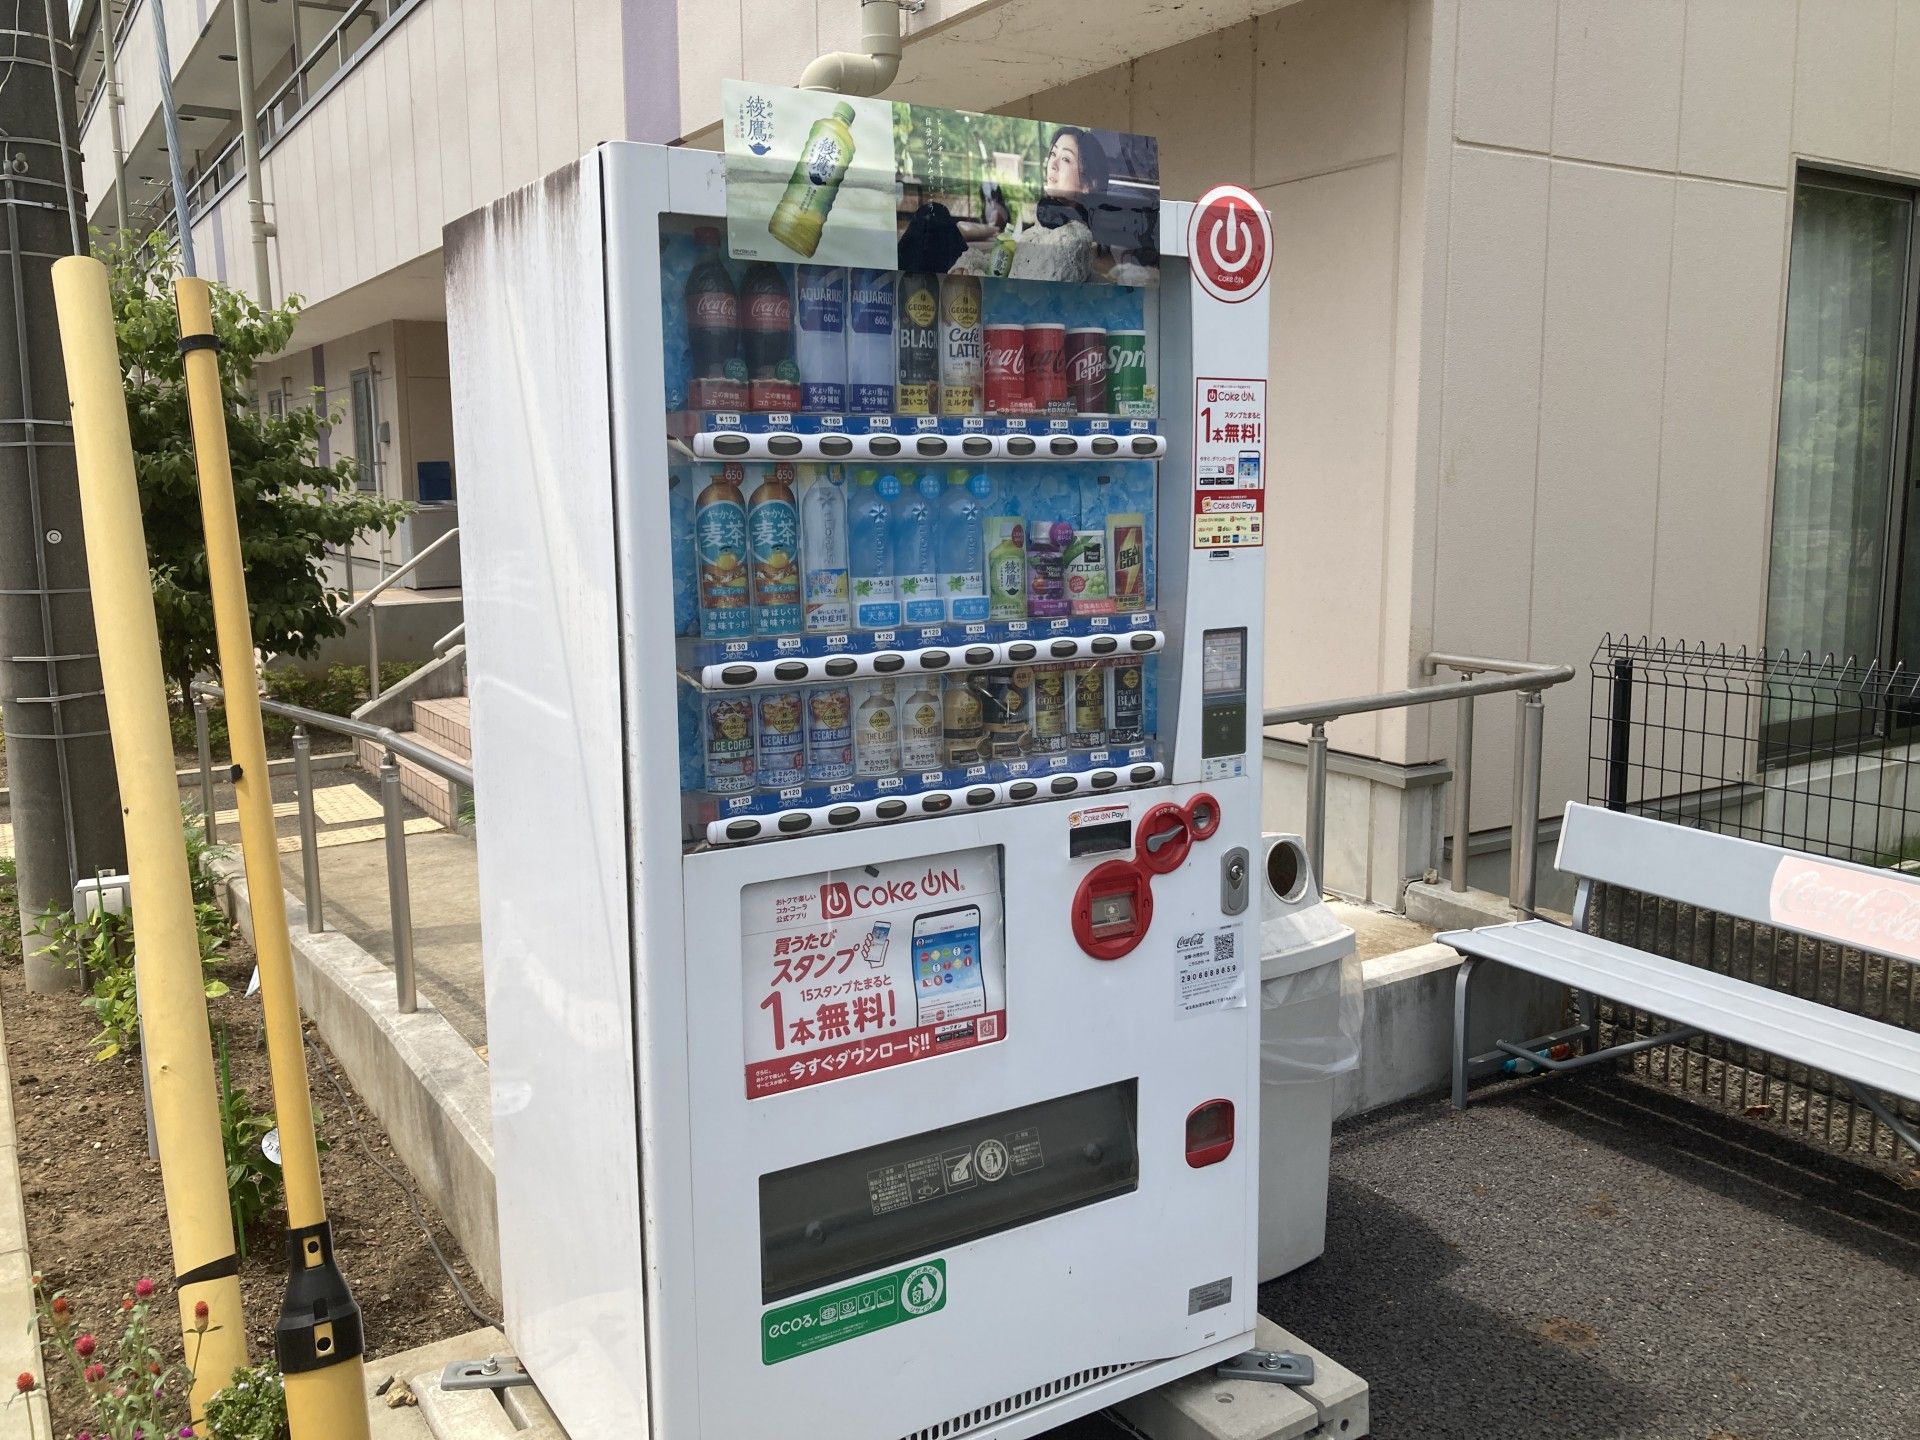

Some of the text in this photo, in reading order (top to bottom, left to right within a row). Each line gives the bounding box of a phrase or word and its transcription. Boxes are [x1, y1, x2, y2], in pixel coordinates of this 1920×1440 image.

[746, 95, 767, 142] 綾鷹
[766, 100, 775, 140] あやたか
[813, 136, 838, 177] 綾鷹
[1217, 275, 1233, 283] Coke
[800, 287, 843, 302] AQUARIUS
[852, 289, 894, 305] AQUARIUS
[949, 327, 979, 342] Café
[949, 343, 979, 358] LATTE
[1088, 352, 1102, 367] Dr
[1218, 390, 1255, 402] Coke ON
[719, 414, 737, 423] ¥170
[771, 414, 789, 423] ¥170
[1224, 411, 1261, 419] スタンプたまると
[873, 417, 890, 426] ¥160
[1200, 407, 1261, 444] 1本無料!
[726, 469, 743, 481] 650
[777, 468, 793, 481] 650
[1212, 502, 1230, 510] Coke
[1242, 502, 1255, 510] Pay
[708, 509, 738, 520] やかん
[759, 509, 791, 519] やかん
[701, 521, 744, 548] 麦茶
[752, 519, 796, 547] 麦茶
[1004, 560, 1017, 588] 綾鷹
[868, 610, 895, 621] 天然水
[914, 607, 940, 617] 天然水
[961, 605, 985, 615] 天然水
[1010, 622, 1026, 630] ¥120
[782, 639, 799, 648] ¥130
[830, 636, 846, 644] ¥140
[728, 643, 746, 651] ¥130
[822, 730, 838, 741] CAFE
[867, 732, 877, 740] THE
[912, 727, 924, 736] THE
[713, 739, 752, 751] ICE COFFEE
[773, 735, 788, 746] CAFE
[832, 784, 850, 792] ¥120
[881, 779, 897, 787] ¥150
[783, 788, 800, 797] ¥120
[732, 798, 750, 806] ¥120
[1083, 811, 1125, 823] Coke ON Pay
[853, 867, 960, 910] Coke ON
[776, 894, 817, 907] おトクで楽しい
[776, 903, 808, 914] コカ・コーラ
[776, 912, 808, 924] 公式アプリ
[773, 929, 838, 957] 買うたび
[1176, 932, 1205, 949] Coca-Cola
[770, 943, 861, 987] スタンプ
[800, 974, 892, 1003] 15スタンプたまると
[760, 990, 898, 1051] 1本無料!
[906, 1267, 938, 1284] のんだあとは
[910, 1300, 936, 1314] リサイクル
